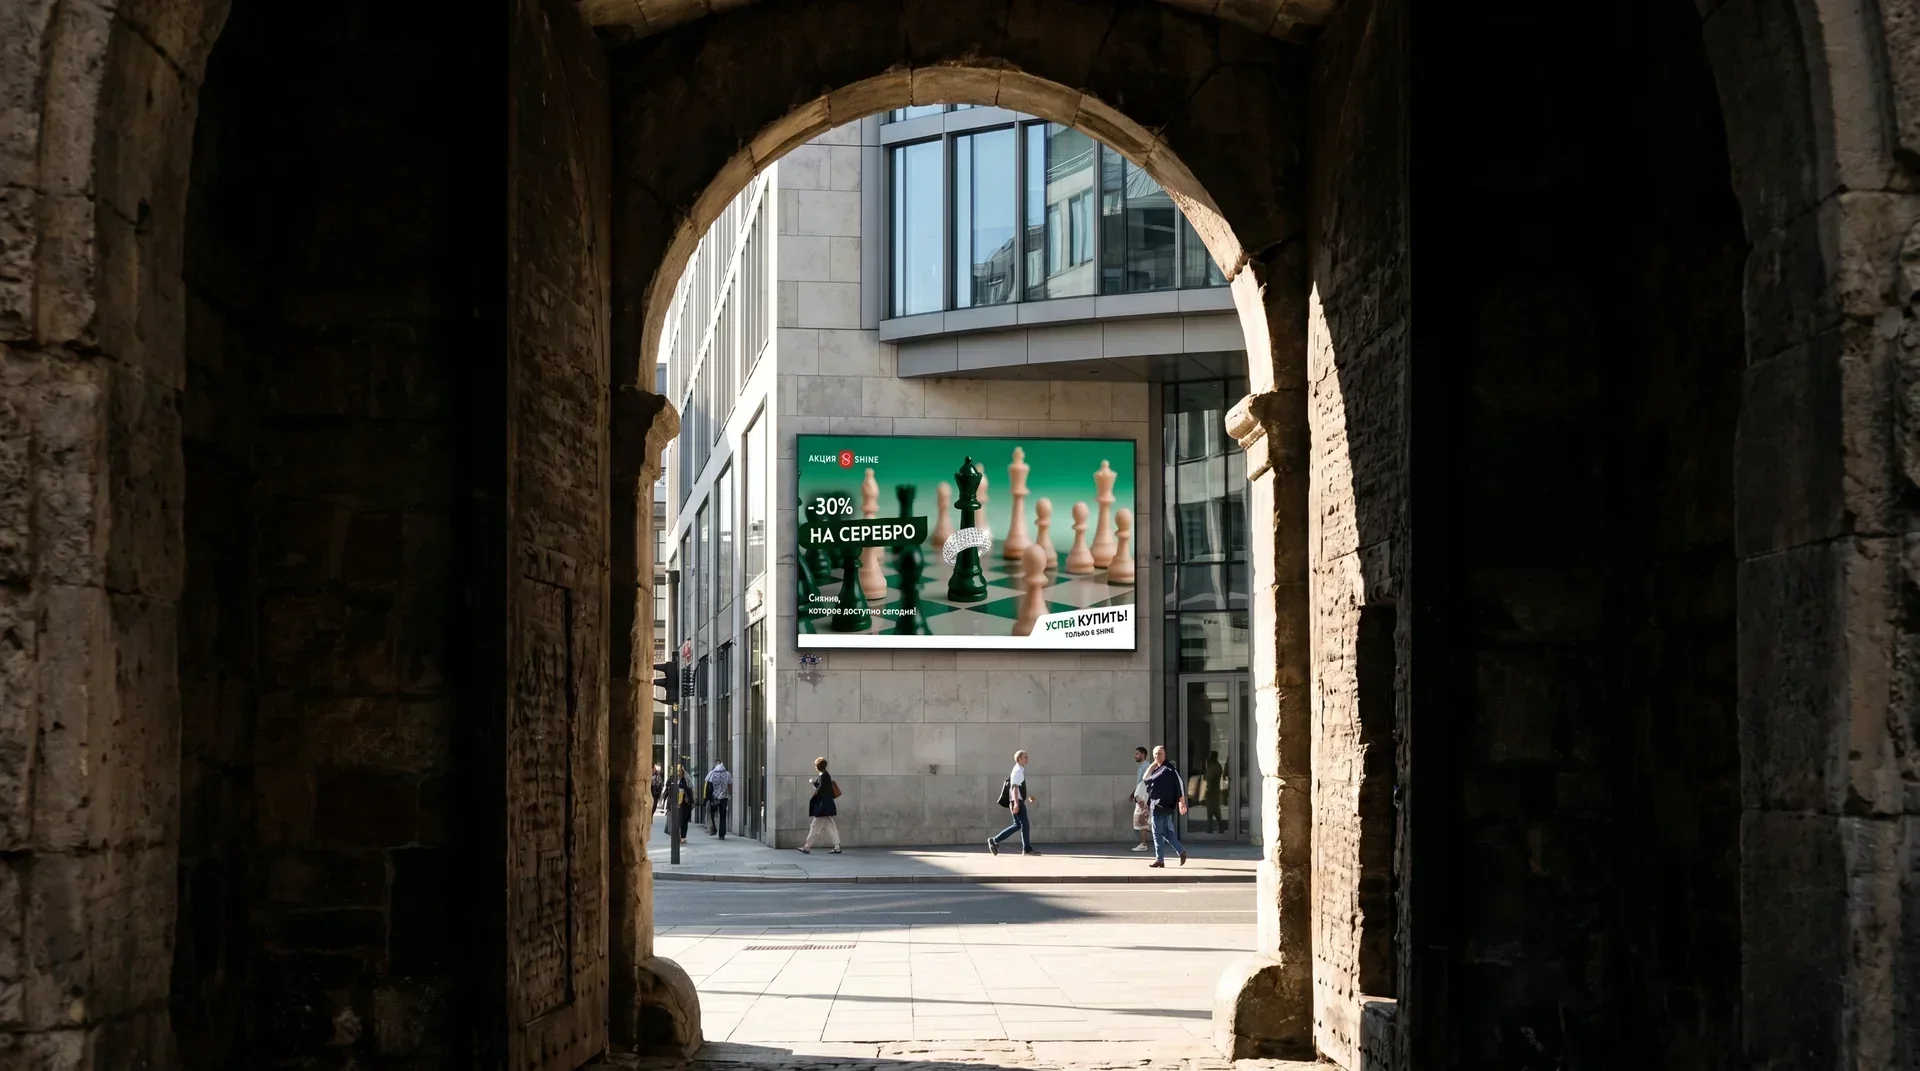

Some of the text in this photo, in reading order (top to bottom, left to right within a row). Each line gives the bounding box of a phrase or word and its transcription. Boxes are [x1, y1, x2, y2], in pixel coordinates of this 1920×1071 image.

[808, 454, 836, 464] АКЦИЯ
[854, 455, 879, 464] SHINE
[807, 497, 854, 515] -30%
[810, 523, 916, 544] НА СЕРЕБРО
[808, 606, 917, 617] которое доступно сегодня!
[1045, 609, 1128, 631] УСПЕЙ КУПИТЬ!
[1065, 629, 1090, 638] ТОЛЬКО
[1095, 626, 1115, 636] SHINE
